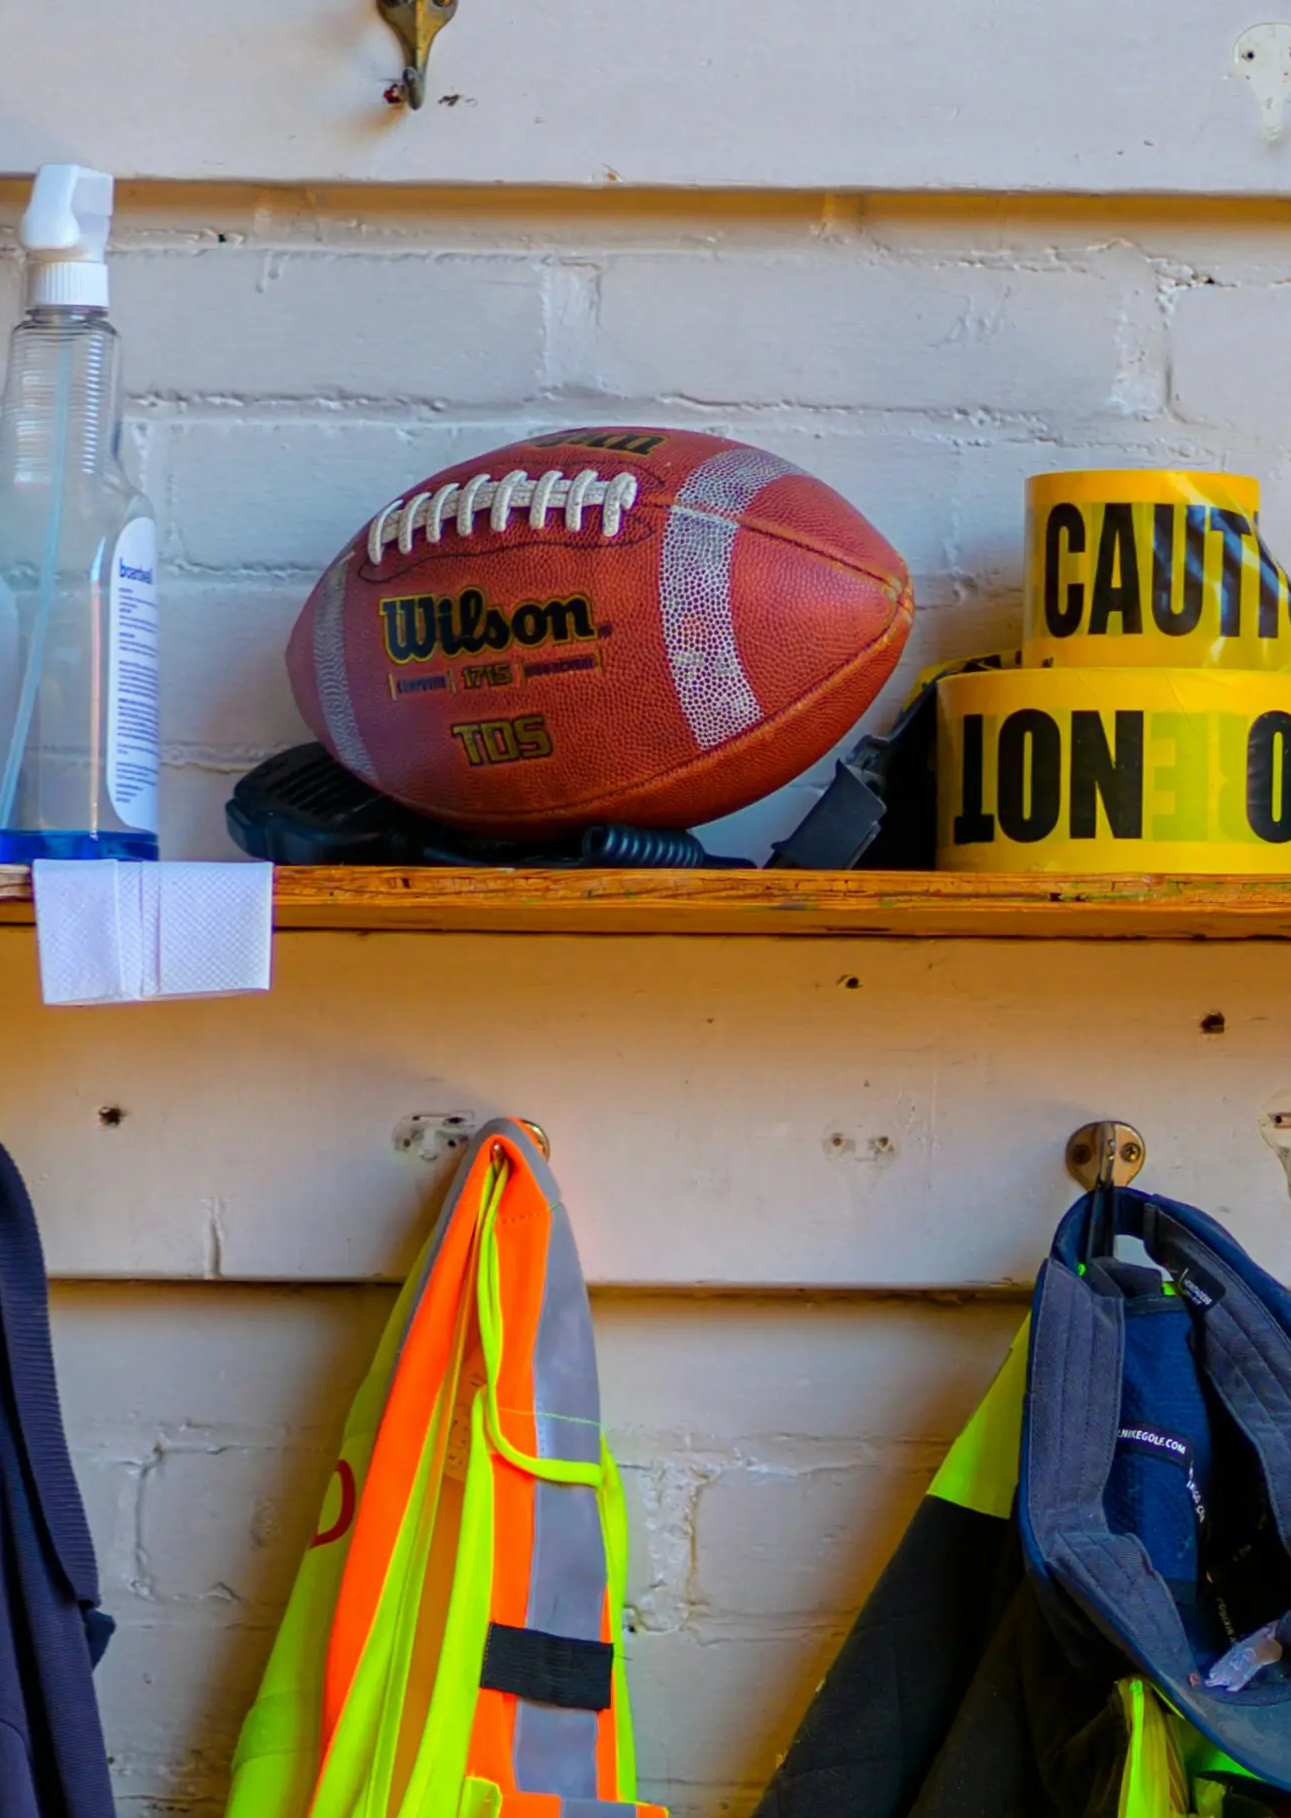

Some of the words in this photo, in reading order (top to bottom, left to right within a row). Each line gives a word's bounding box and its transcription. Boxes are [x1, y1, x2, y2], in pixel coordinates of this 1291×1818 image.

[379, 585, 598, 664] Wilson
[462, 662, 511, 689] 1715
[451, 713, 553, 767] TDS
[953, 708, 1144, 845] NOT
